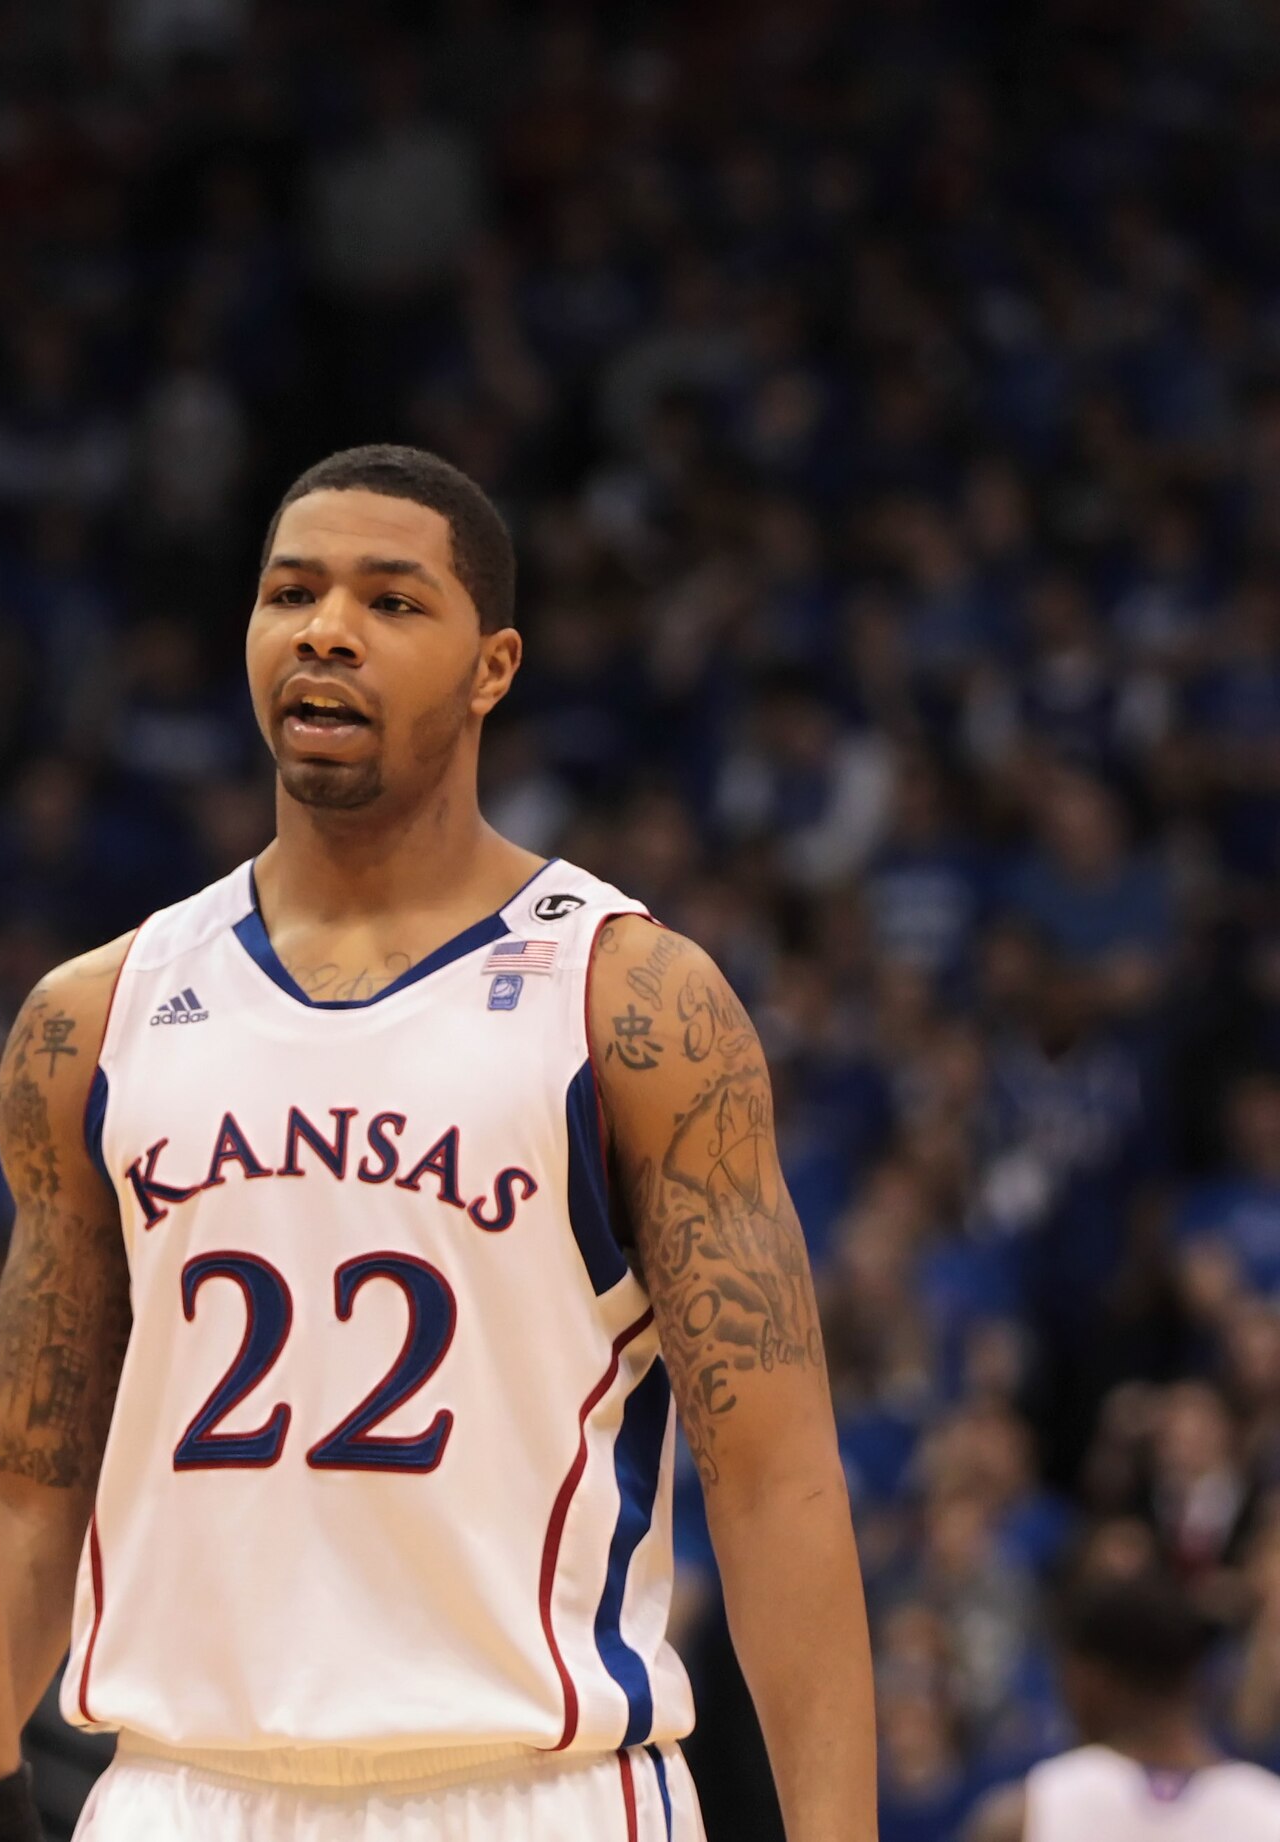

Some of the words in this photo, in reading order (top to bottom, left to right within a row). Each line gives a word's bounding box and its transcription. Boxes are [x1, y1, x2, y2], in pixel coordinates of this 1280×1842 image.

[150, 1010, 209, 1026] adidas
[606, 1003, 663, 1070] 忠
[124, 1105, 538, 1233] KANSAS
[173, 1250, 457, 1474] 22
